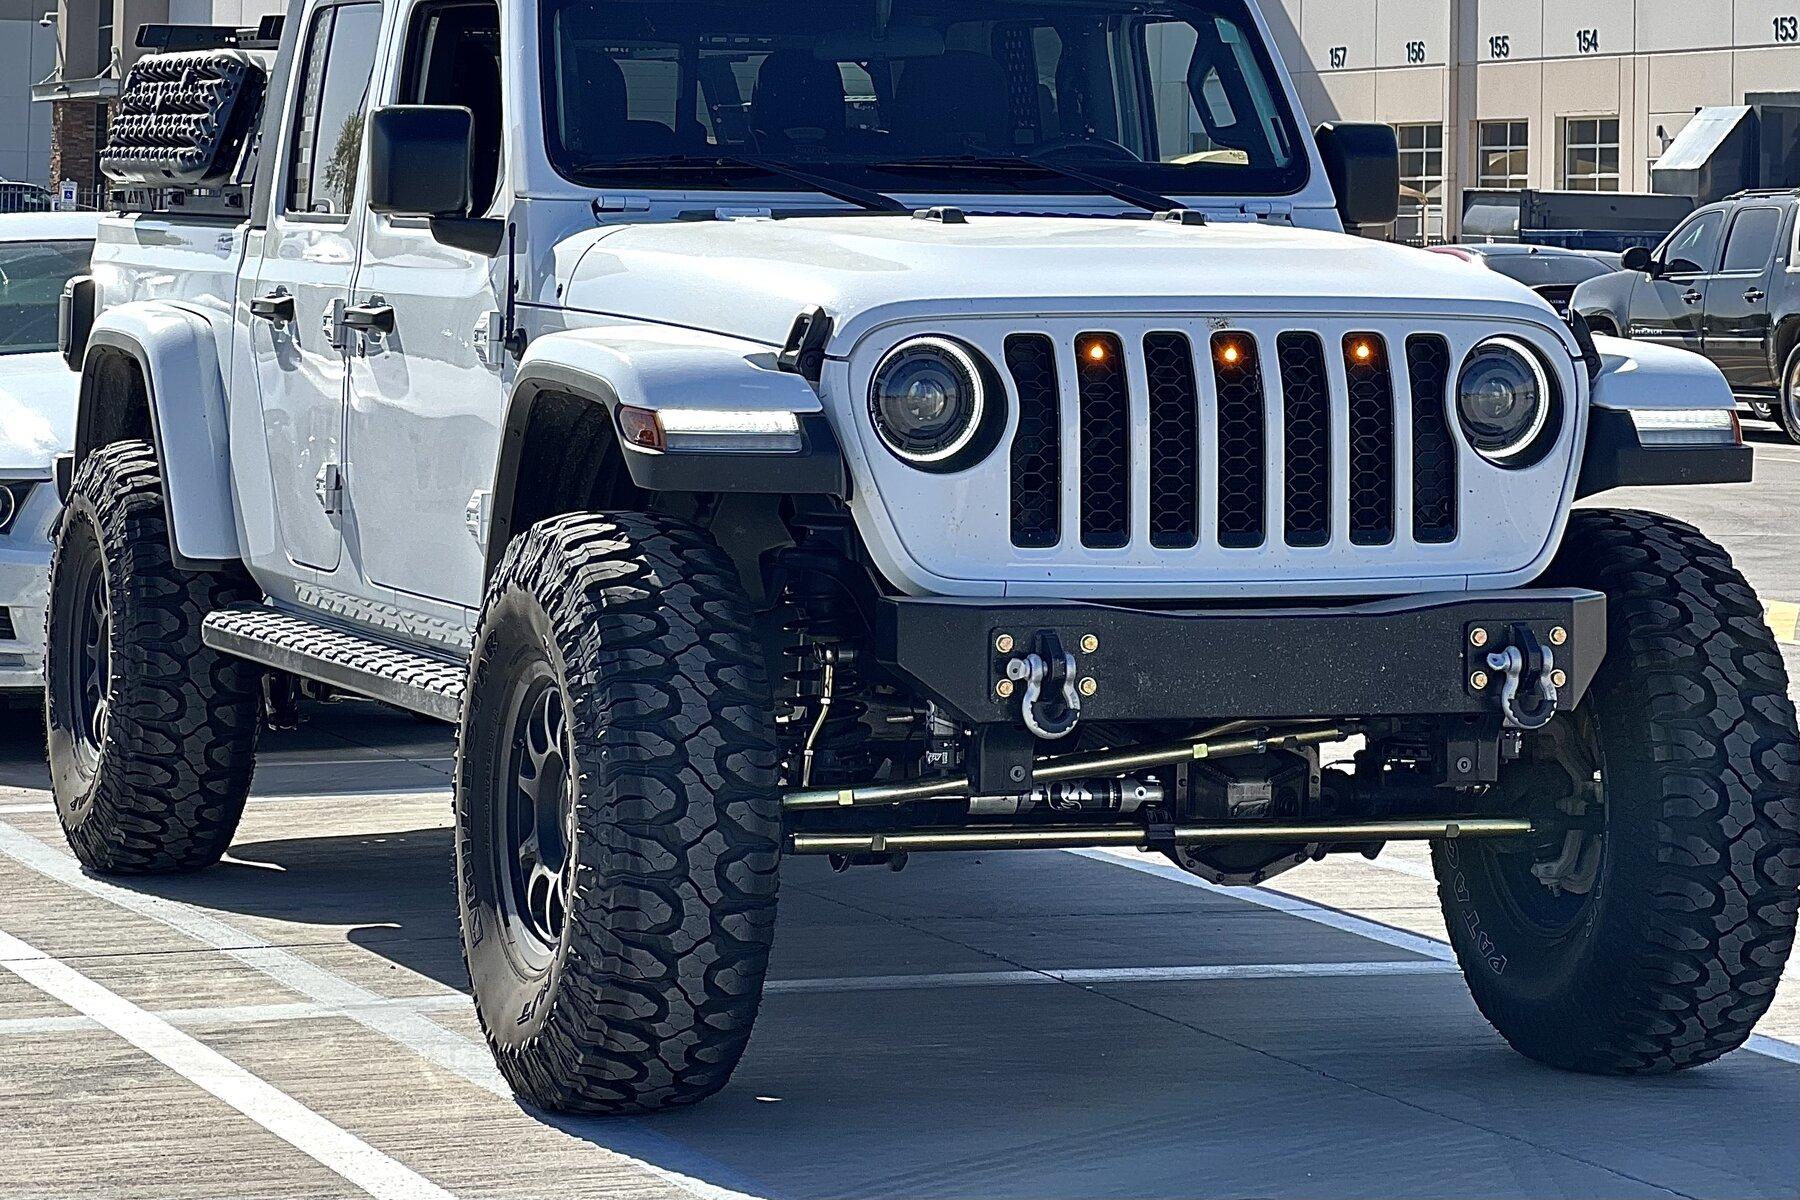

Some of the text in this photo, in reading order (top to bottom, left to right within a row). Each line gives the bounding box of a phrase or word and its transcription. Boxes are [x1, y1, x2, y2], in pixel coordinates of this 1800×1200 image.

[1772, 16, 1798, 42] 153
[1405, 41, 1425, 63] 156
[1488, 35, 1510, 58] 155
[1576, 29, 1599, 53] 154
[1329, 46, 1347, 68] 157
